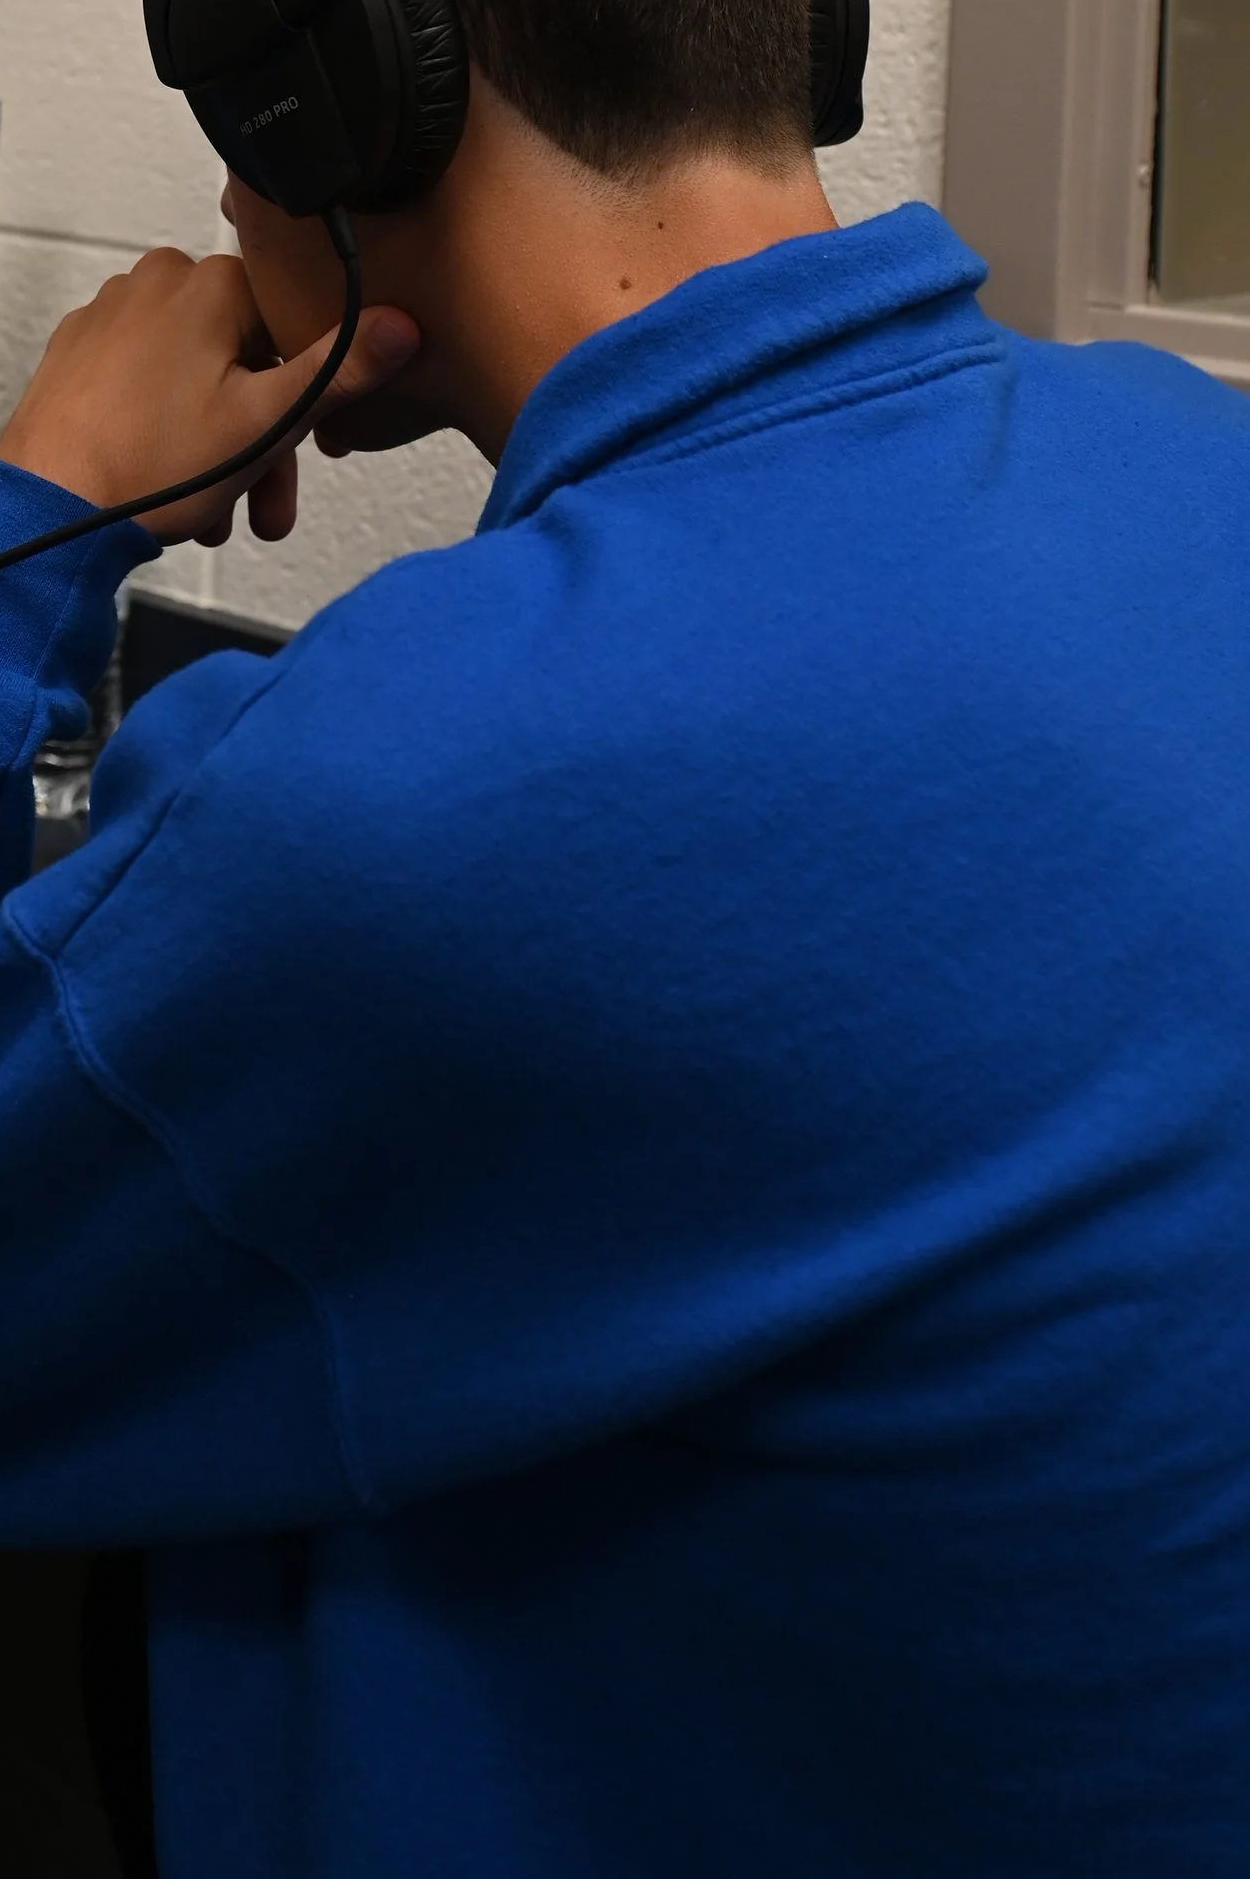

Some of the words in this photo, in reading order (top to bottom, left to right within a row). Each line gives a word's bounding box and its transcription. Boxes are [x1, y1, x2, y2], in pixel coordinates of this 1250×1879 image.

[239, 121, 253, 137] HD
[252, 109, 273, 129] 280
[273, 96, 299, 118] PRO
